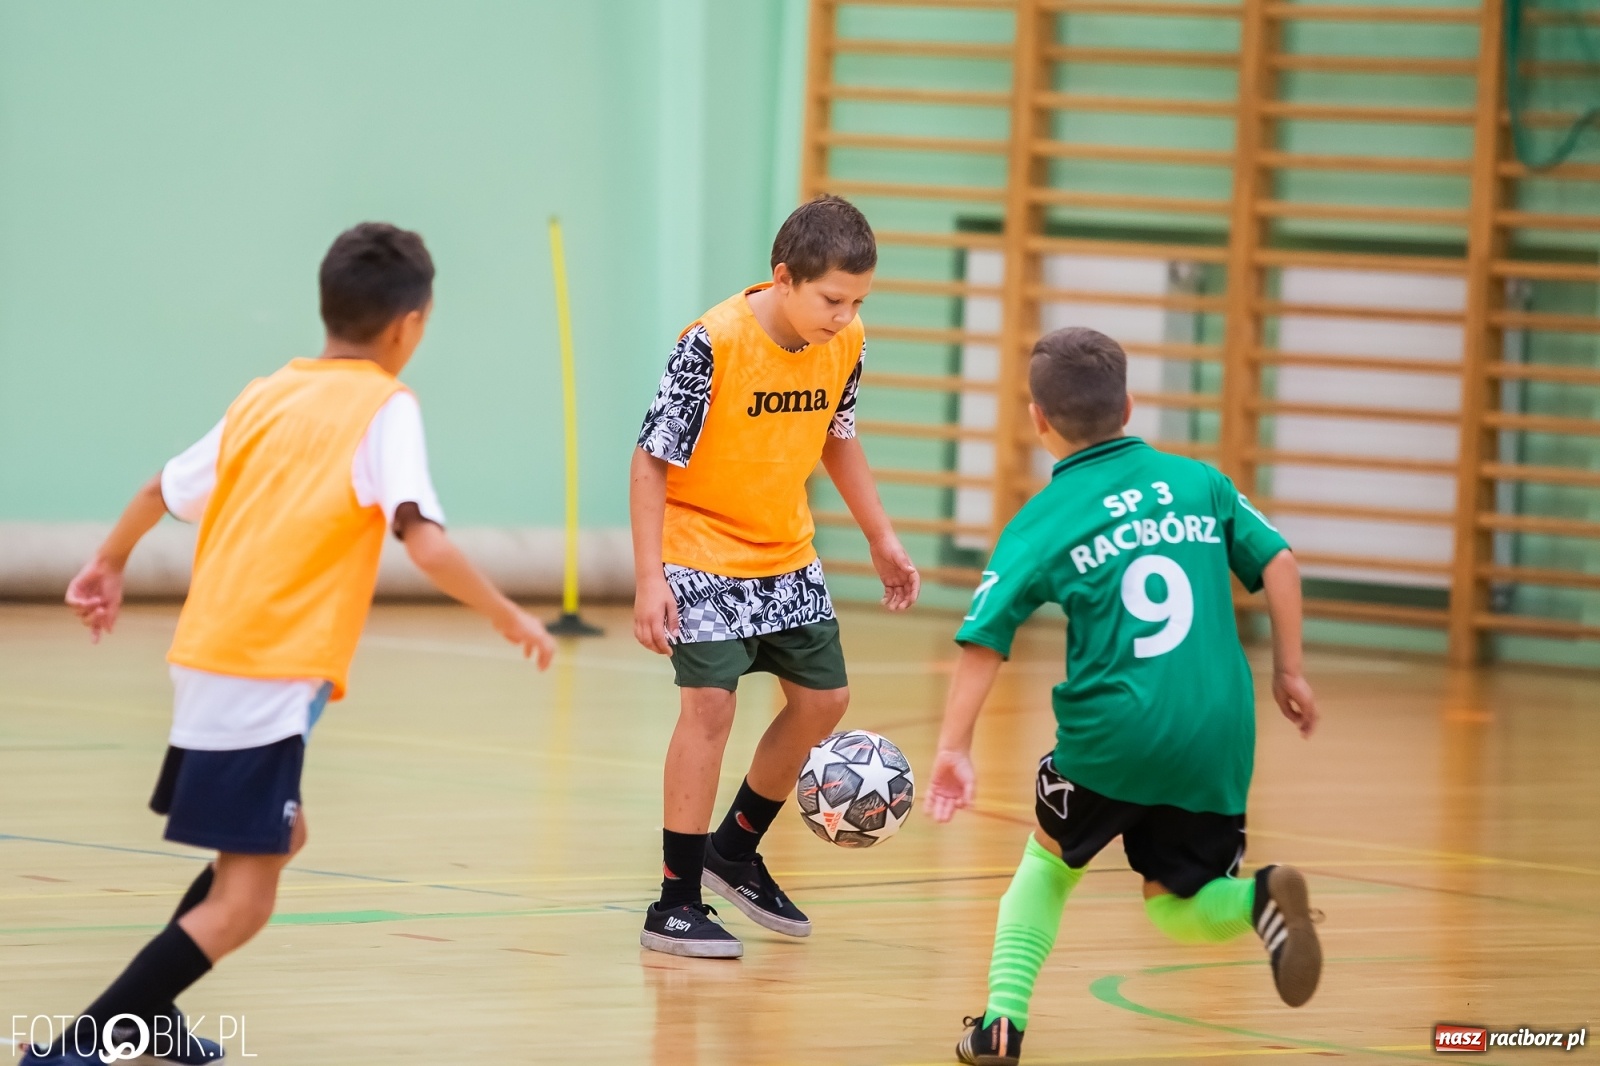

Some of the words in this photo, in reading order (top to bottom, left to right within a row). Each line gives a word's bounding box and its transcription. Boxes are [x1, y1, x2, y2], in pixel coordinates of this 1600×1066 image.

[747, 388, 829, 417] Joma
[1103, 489, 1143, 518] SP
[1150, 481, 1174, 505] 3
[1070, 511, 1221, 574] RACIBÓRZ
[1120, 554, 1194, 659] 9
[665, 916, 692, 932] NASA
